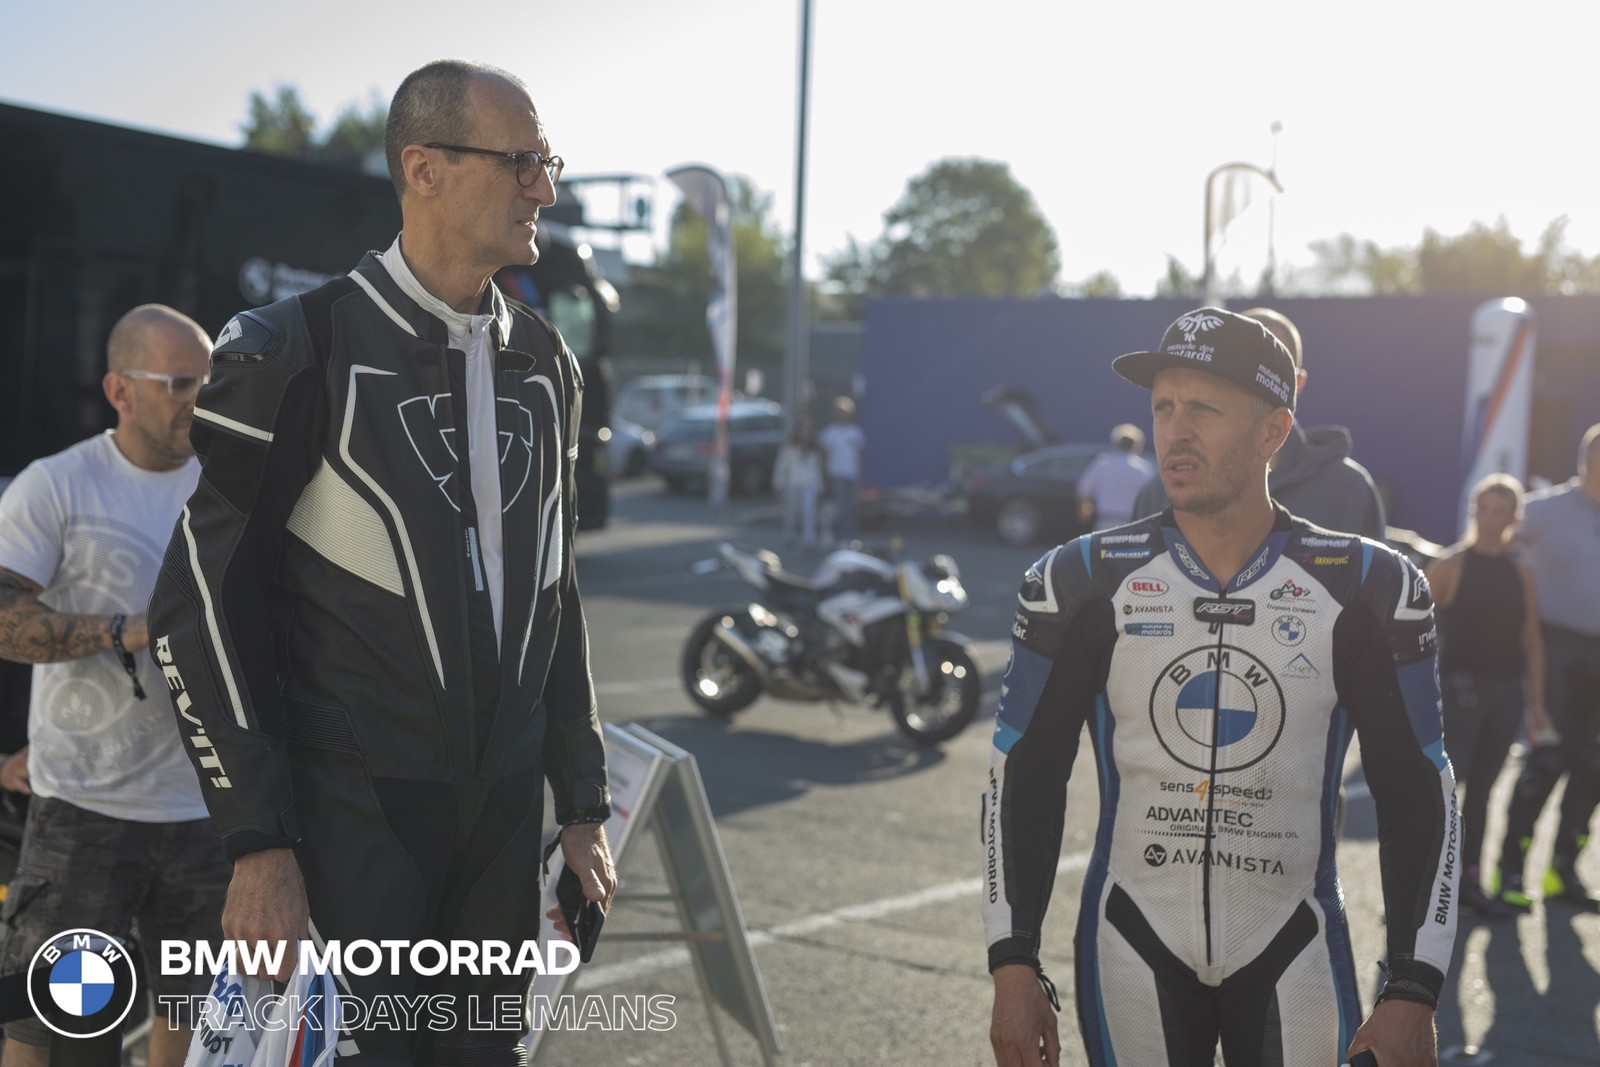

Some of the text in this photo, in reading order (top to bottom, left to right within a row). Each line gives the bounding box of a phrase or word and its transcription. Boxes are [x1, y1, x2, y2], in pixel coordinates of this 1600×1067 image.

[1256, 372, 1289, 403] motards
[1175, 543, 1209, 580] RST
[1236, 546, 1269, 587] RST
[1132, 582, 1164, 592] BELL
[1134, 605, 1174, 614] AVANISTA
[1196, 603, 1252, 614] RST
[1218, 825, 1244, 836] BMW
[1246, 831, 1283, 839] ENGINE
[1172, 849, 1284, 876] AVANISTA
[1434, 881, 1451, 926] BMW
